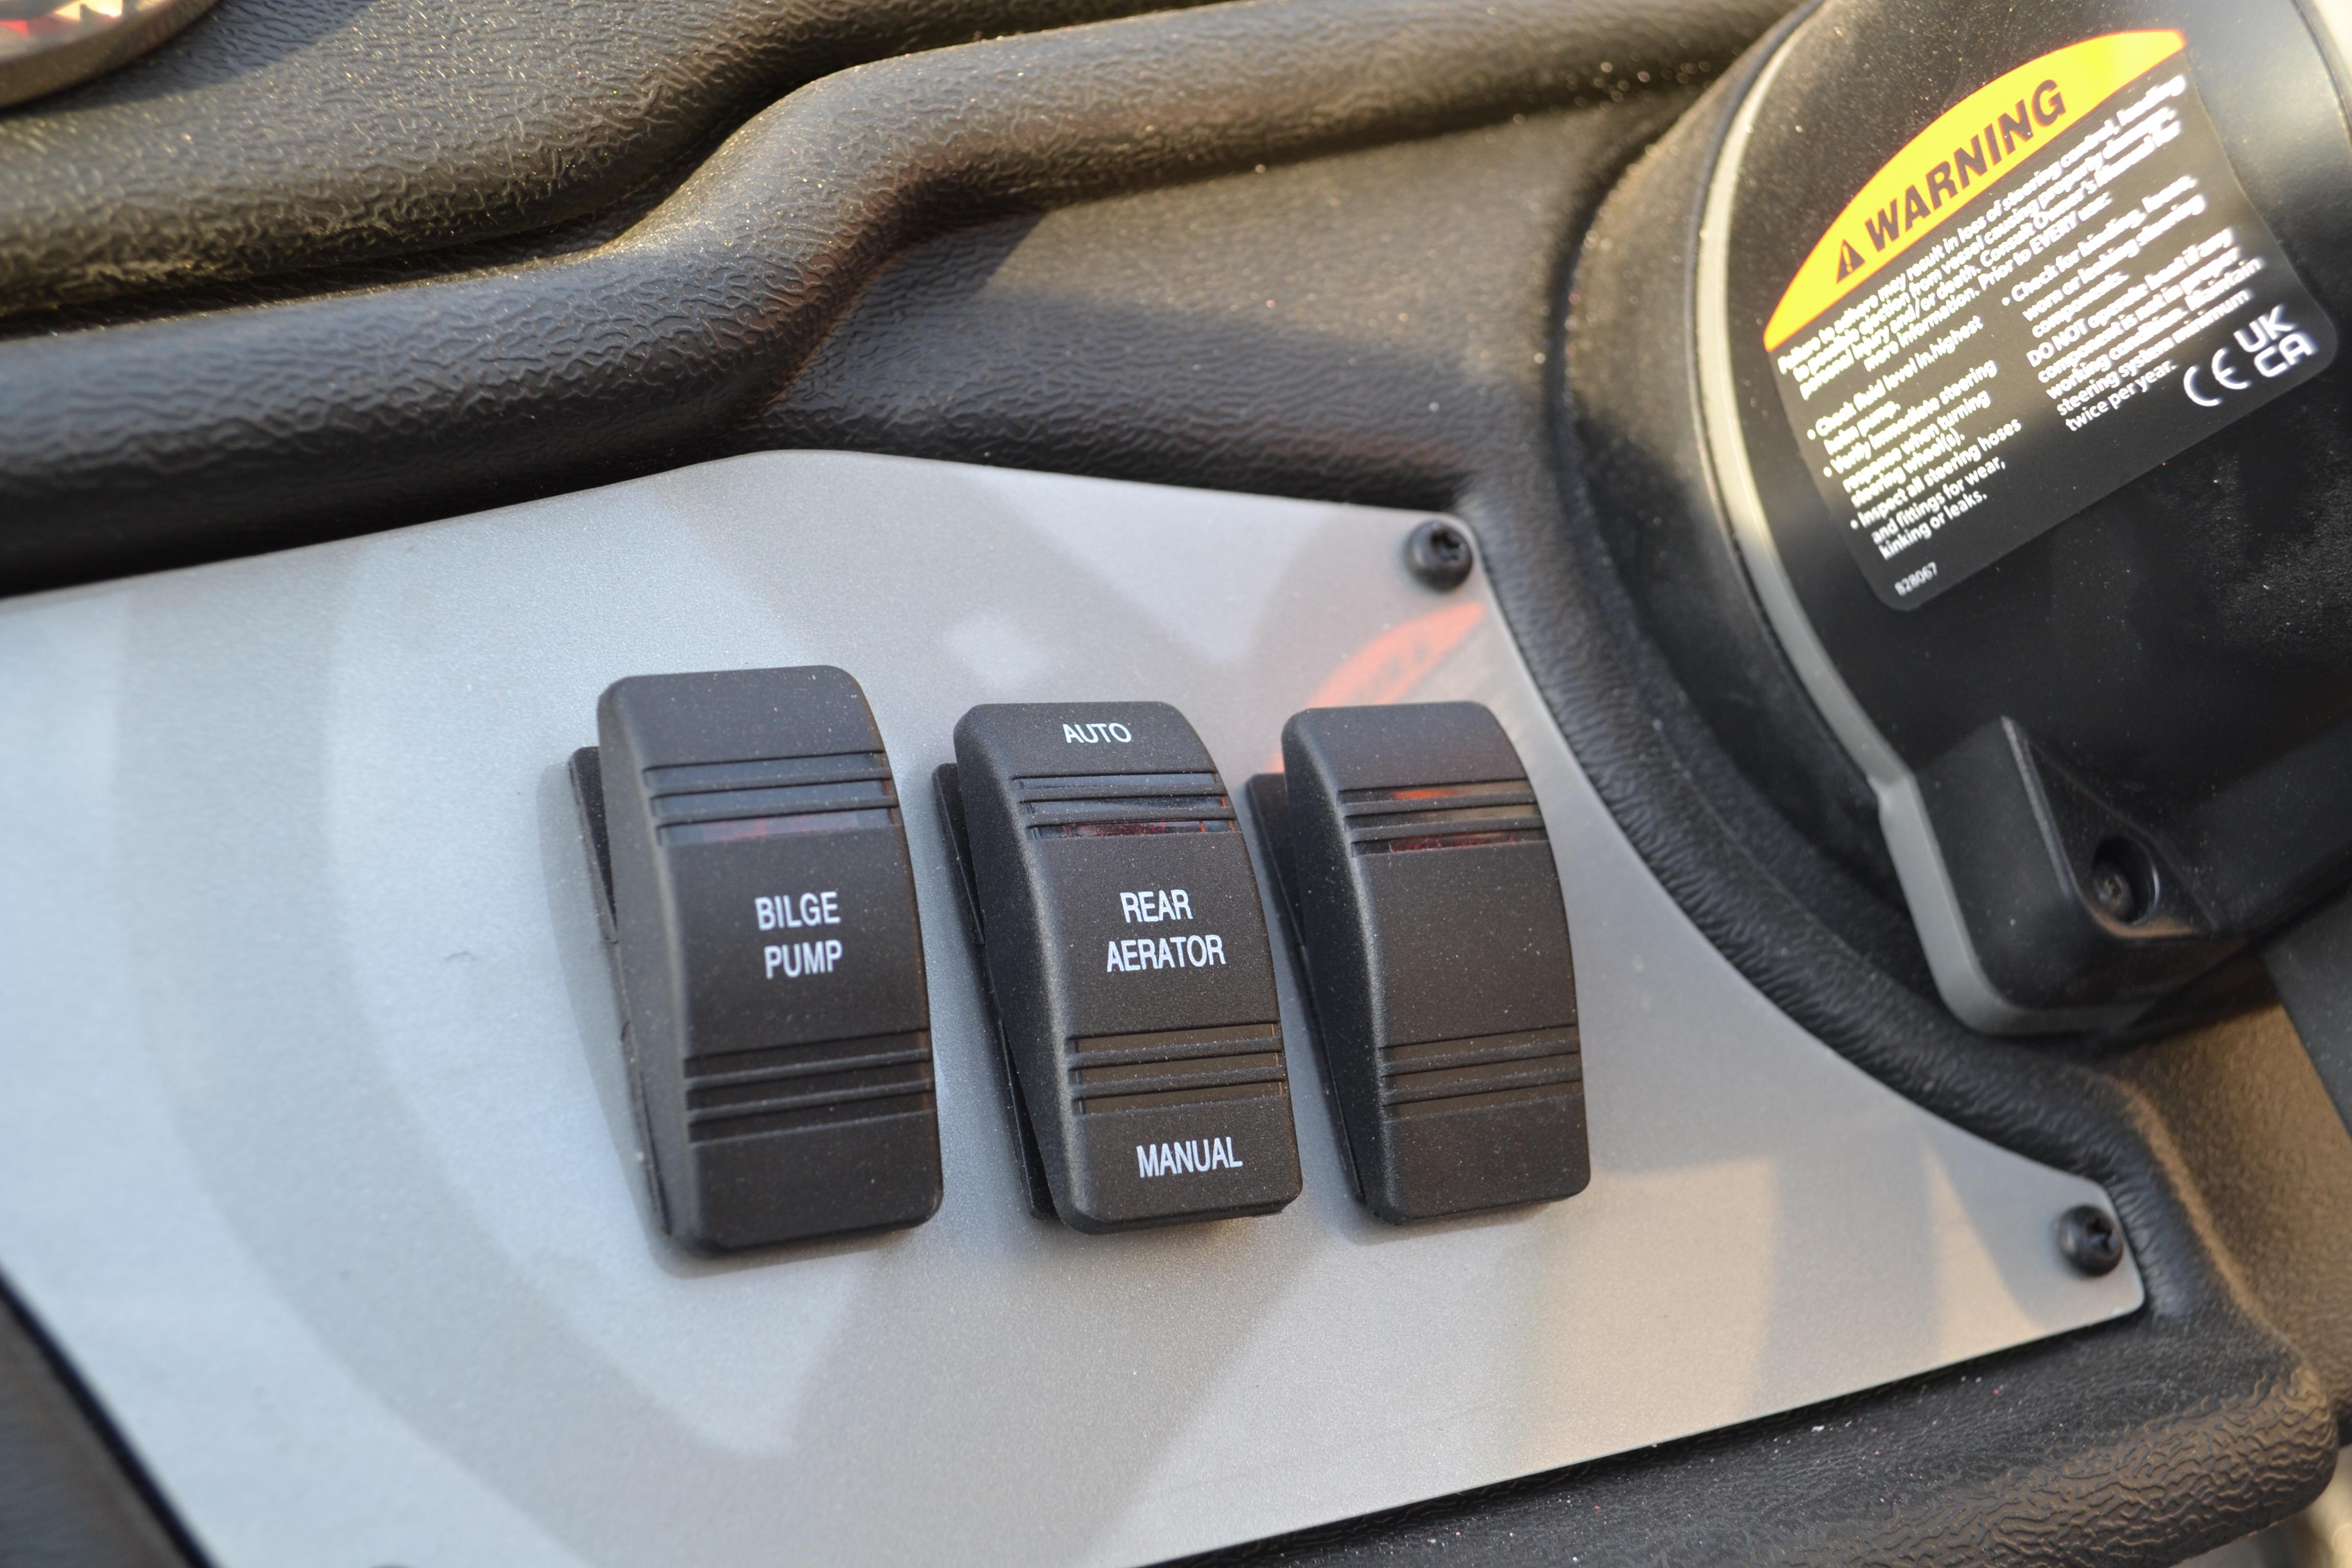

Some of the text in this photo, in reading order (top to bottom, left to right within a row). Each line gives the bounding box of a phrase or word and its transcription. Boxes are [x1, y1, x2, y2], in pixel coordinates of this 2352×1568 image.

[1865, 79, 2066, 252] WARNING
[1792, 364, 1809, 381] to
[1858, 292, 1910, 334] ejection
[1908, 268, 1942, 299] from
[1941, 235, 1984, 274] vessel
[1983, 199, 2041, 244] causing
[1819, 327, 1835, 344] to
[1877, 273, 1905, 301] may
[1906, 244, 1945, 281] result
[1943, 236, 1958, 253] in
[1957, 216, 1987, 243] loss
[1986, 200, 2002, 222] of
[2001, 161, 2063, 211] steering
[1851, 326, 1889, 359] injury
[1889, 292, 1935, 333] and/or
[1936, 264, 1980, 299] death.
[1980, 222, 2036, 267] Consult
[1864, 340, 1898, 371] more
[1896, 287, 1979, 348] information.
[1977, 259, 2013, 290] Prior
[2013, 249, 2031, 265] to
[2029, 210, 2077, 254] EVERY
[2011, 265, 2059, 301] Check
[2055, 249, 2079, 272] for
[2022, 194, 2206, 321] worn or leaking steering
[2026, 342, 2054, 366] DO
[2051, 318, 2087, 351] NOT
[2182, 245, 2199, 266] if
[2196, 229, 2233, 257] any
[2038, 247, 2238, 382] component is not in proper
[2046, 354, 2112, 399] working
[2184, 258, 2261, 311] Maintain
[2233, 305, 2294, 352] UK
[1815, 315, 1983, 436] Check fluid level in highest
[2056, 290, 2249, 415] steering system minimum
[2183, 348, 2249, 406] CE
[2253, 332, 2315, 377] CA
[1830, 360, 1997, 473] Verify immediate steering
[1900, 423, 1940, 454] when
[1937, 390, 1991, 430] turning
[2065, 360, 2176, 431] twice per year.
[1851, 428, 1965, 507] steering wheel(s).
[1857, 419, 2021, 526] Inspect all steering hoses
[1872, 457, 2005, 544] and fittings for wear,
[1879, 491, 1987, 558] kinking or leaks.
[1063, 723, 1132, 743] AUTO
[754, 891, 840, 930] BILGE
[1120, 889, 1193, 923] REAR
[764, 940, 842, 978] PUMP
[1107, 935, 1226, 972] AERATOR
[1136, 1137, 1243, 1178] MANUAL
